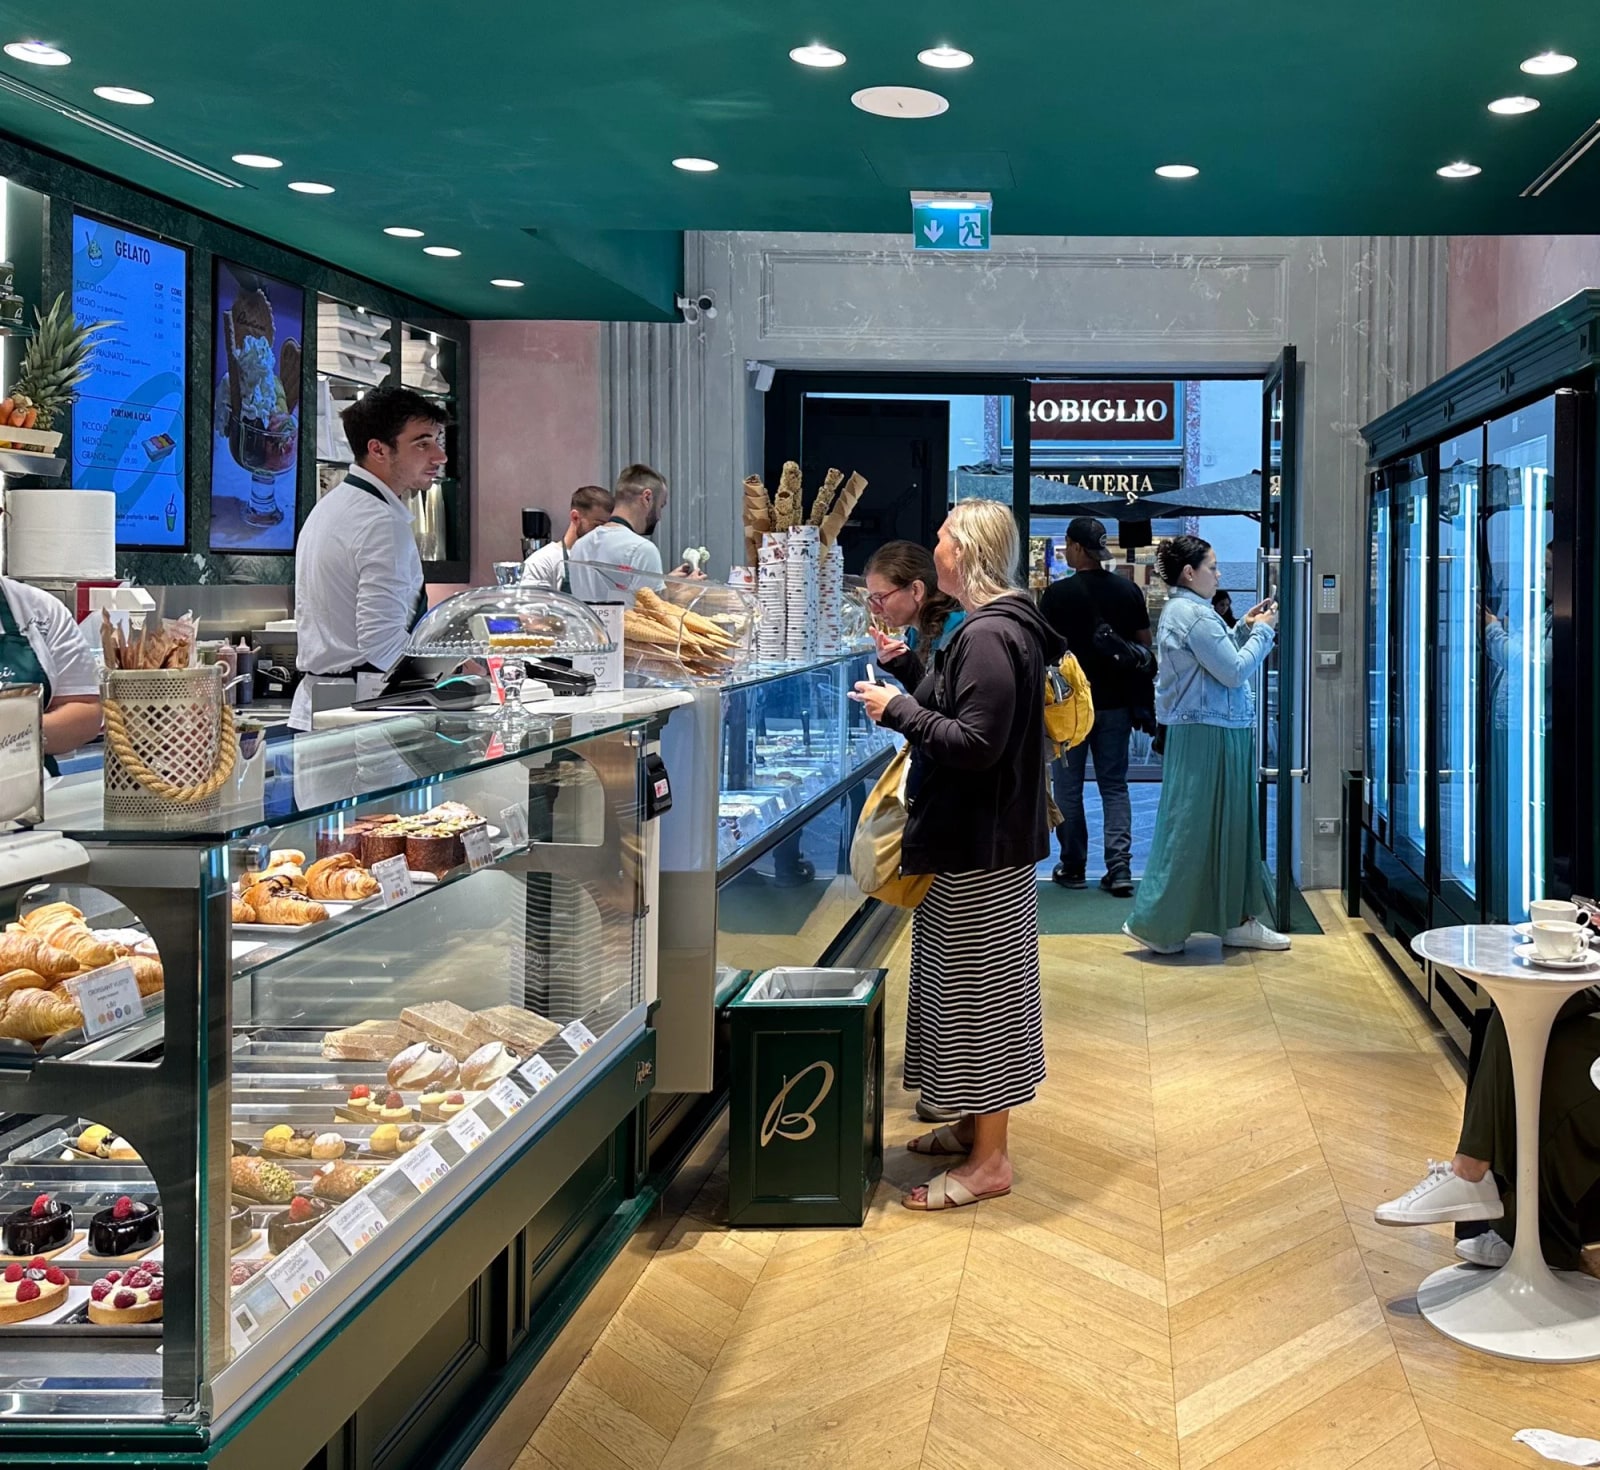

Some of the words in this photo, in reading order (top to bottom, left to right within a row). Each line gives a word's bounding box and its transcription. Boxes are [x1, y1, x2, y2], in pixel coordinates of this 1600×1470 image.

[114, 240, 151, 266] GELATO
[76, 280, 103, 295] PICCOLO
[76, 296, 96, 308] MEDIO
[111, 407, 133, 419] PORTAMI
[138, 413, 152, 422] CASA
[82, 421, 108, 433] PICCOLO
[82, 436, 102, 447] MEDIO
[82, 450, 106, 461] GRANDE
[1035, 474, 1154, 492] LATERIA
